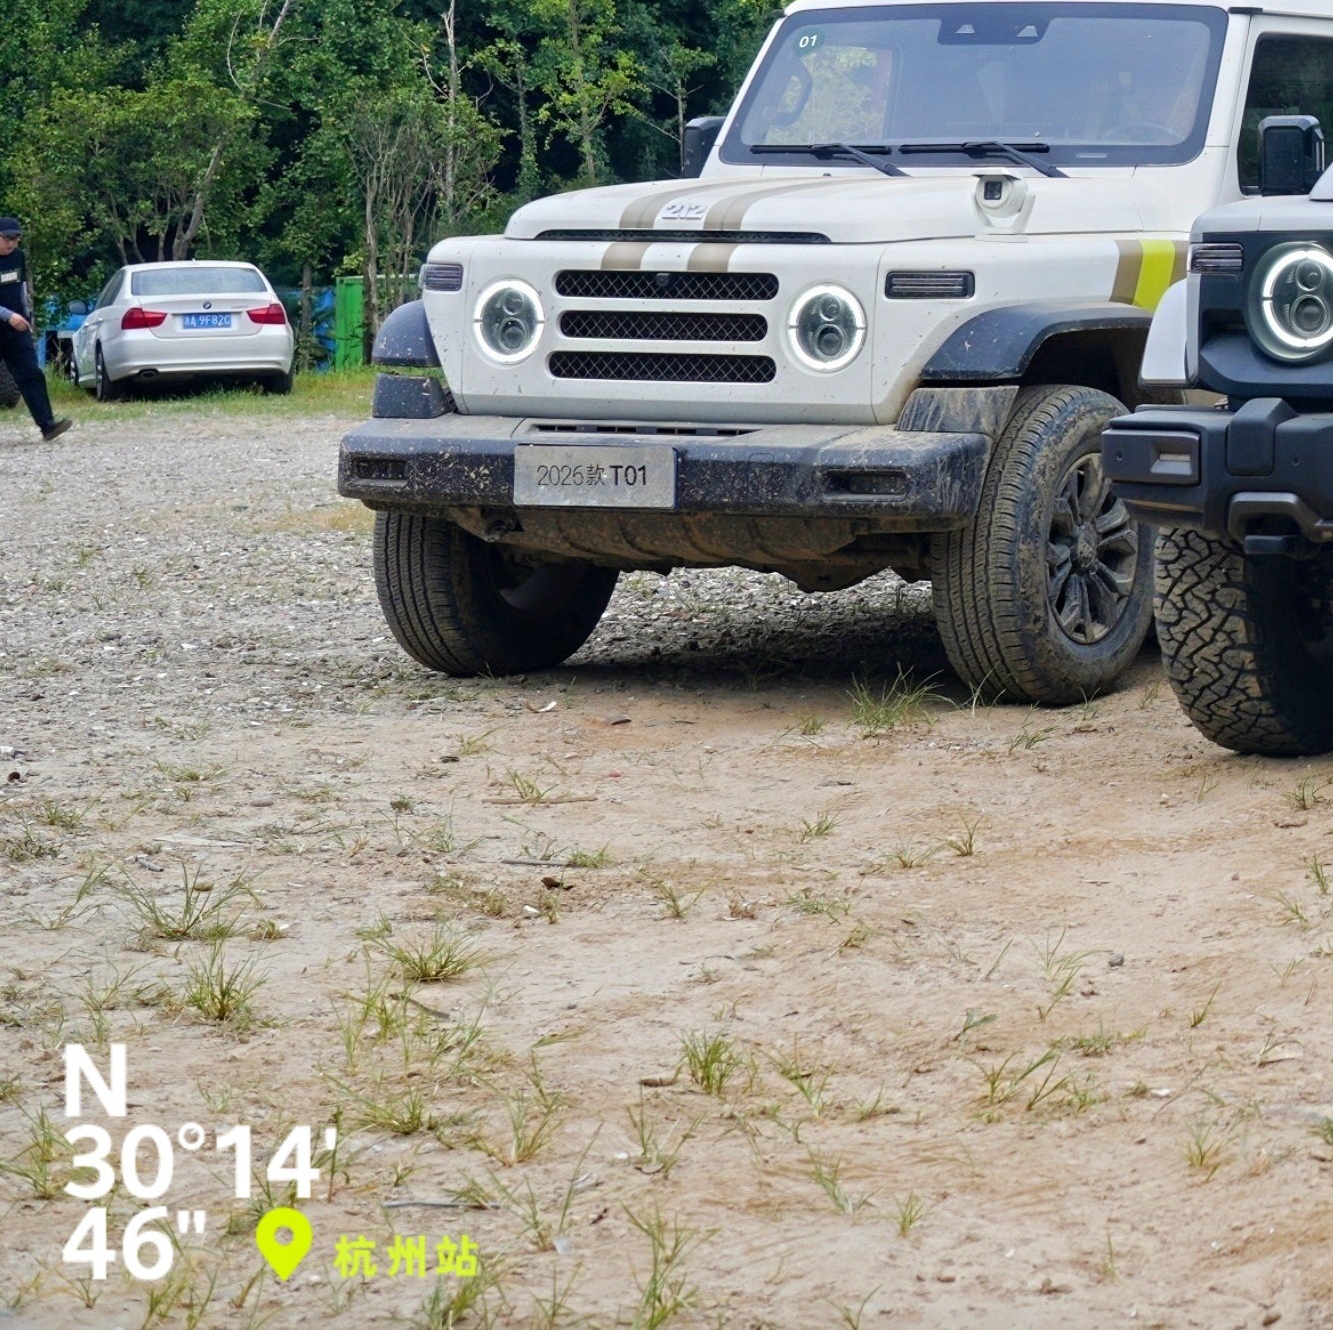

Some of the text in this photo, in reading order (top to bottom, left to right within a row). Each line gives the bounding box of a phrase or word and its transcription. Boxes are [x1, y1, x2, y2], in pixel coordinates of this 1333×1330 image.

[798, 34, 818, 48] 01
[661, 202, 705, 220] 212
[536, 463, 648, 486] 2026款 T01
